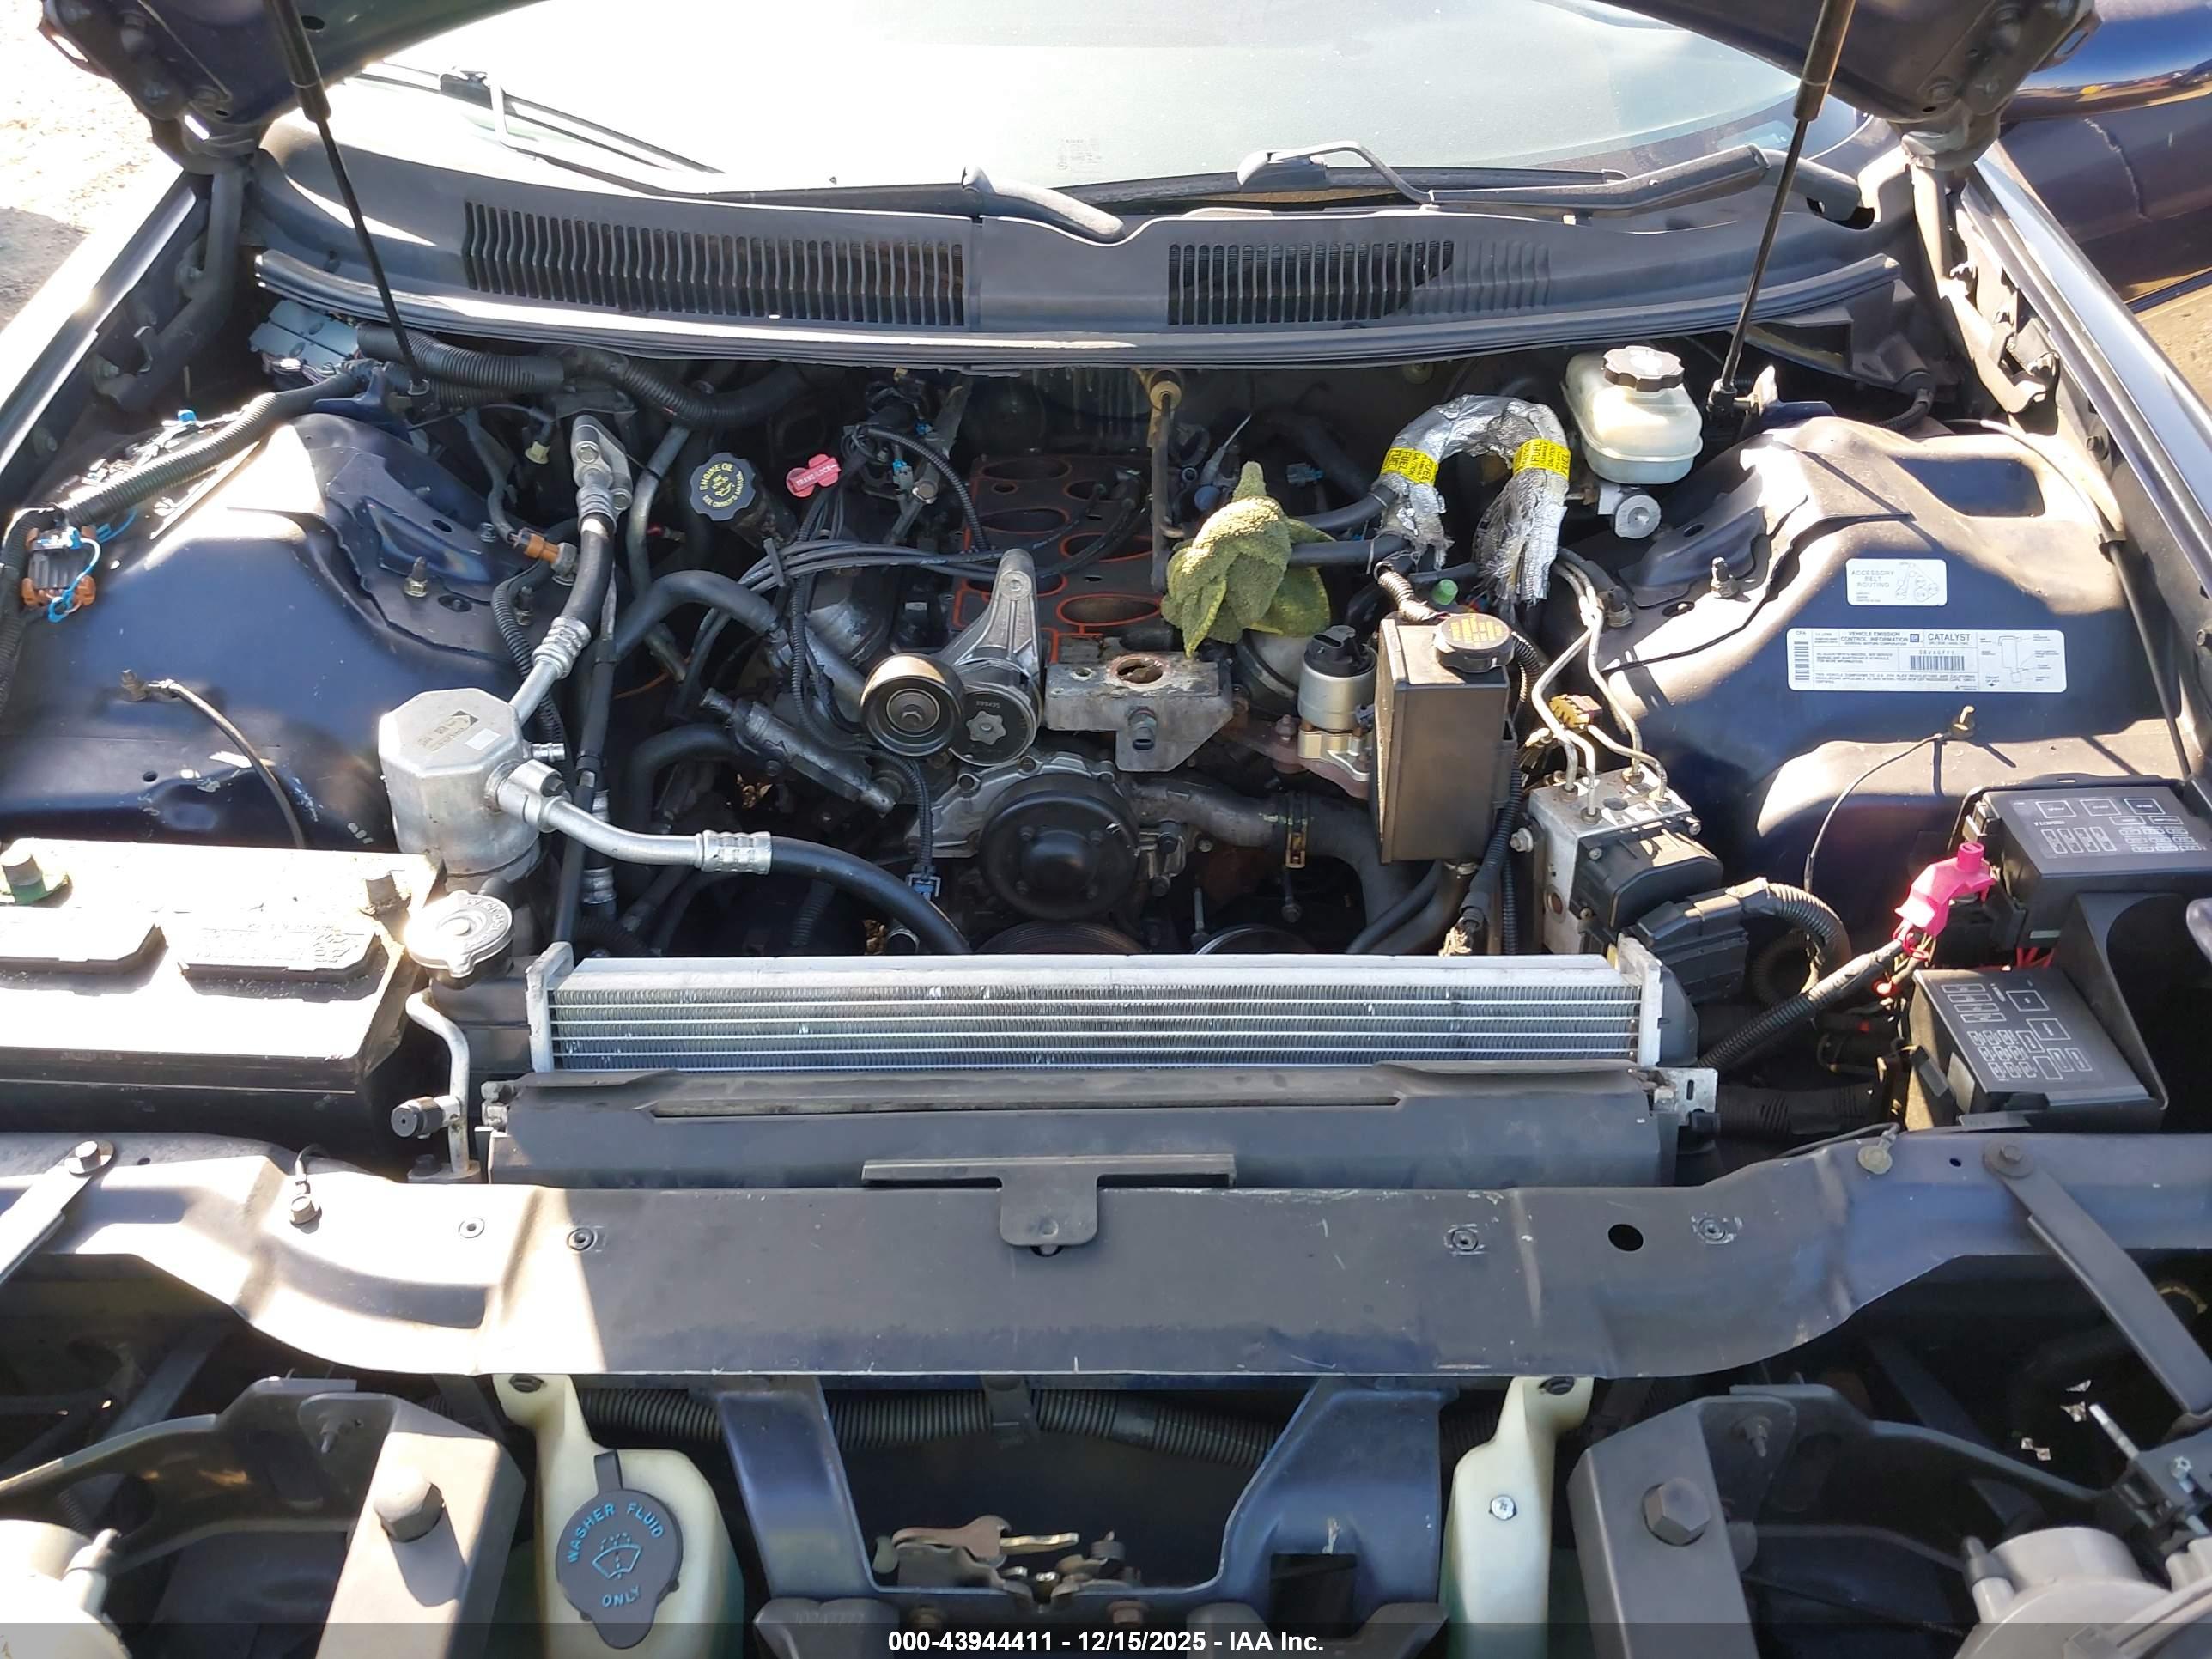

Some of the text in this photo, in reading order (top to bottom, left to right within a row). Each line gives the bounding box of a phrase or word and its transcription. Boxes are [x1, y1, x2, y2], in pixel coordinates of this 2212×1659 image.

[1388, 450, 1401, 469] FUEL
[1398, 451, 1412, 470] FUEL
[1532, 441, 1542, 462] FUEL
[699, 462, 734, 491] ENGINE OIL
[1422, 458, 1434, 481] FUEL
[1928, 633, 1971, 641] CATALYST
[566, 1502, 665, 1564] WASHER FLUID
[601, 1585, 641, 1608] ONLY
